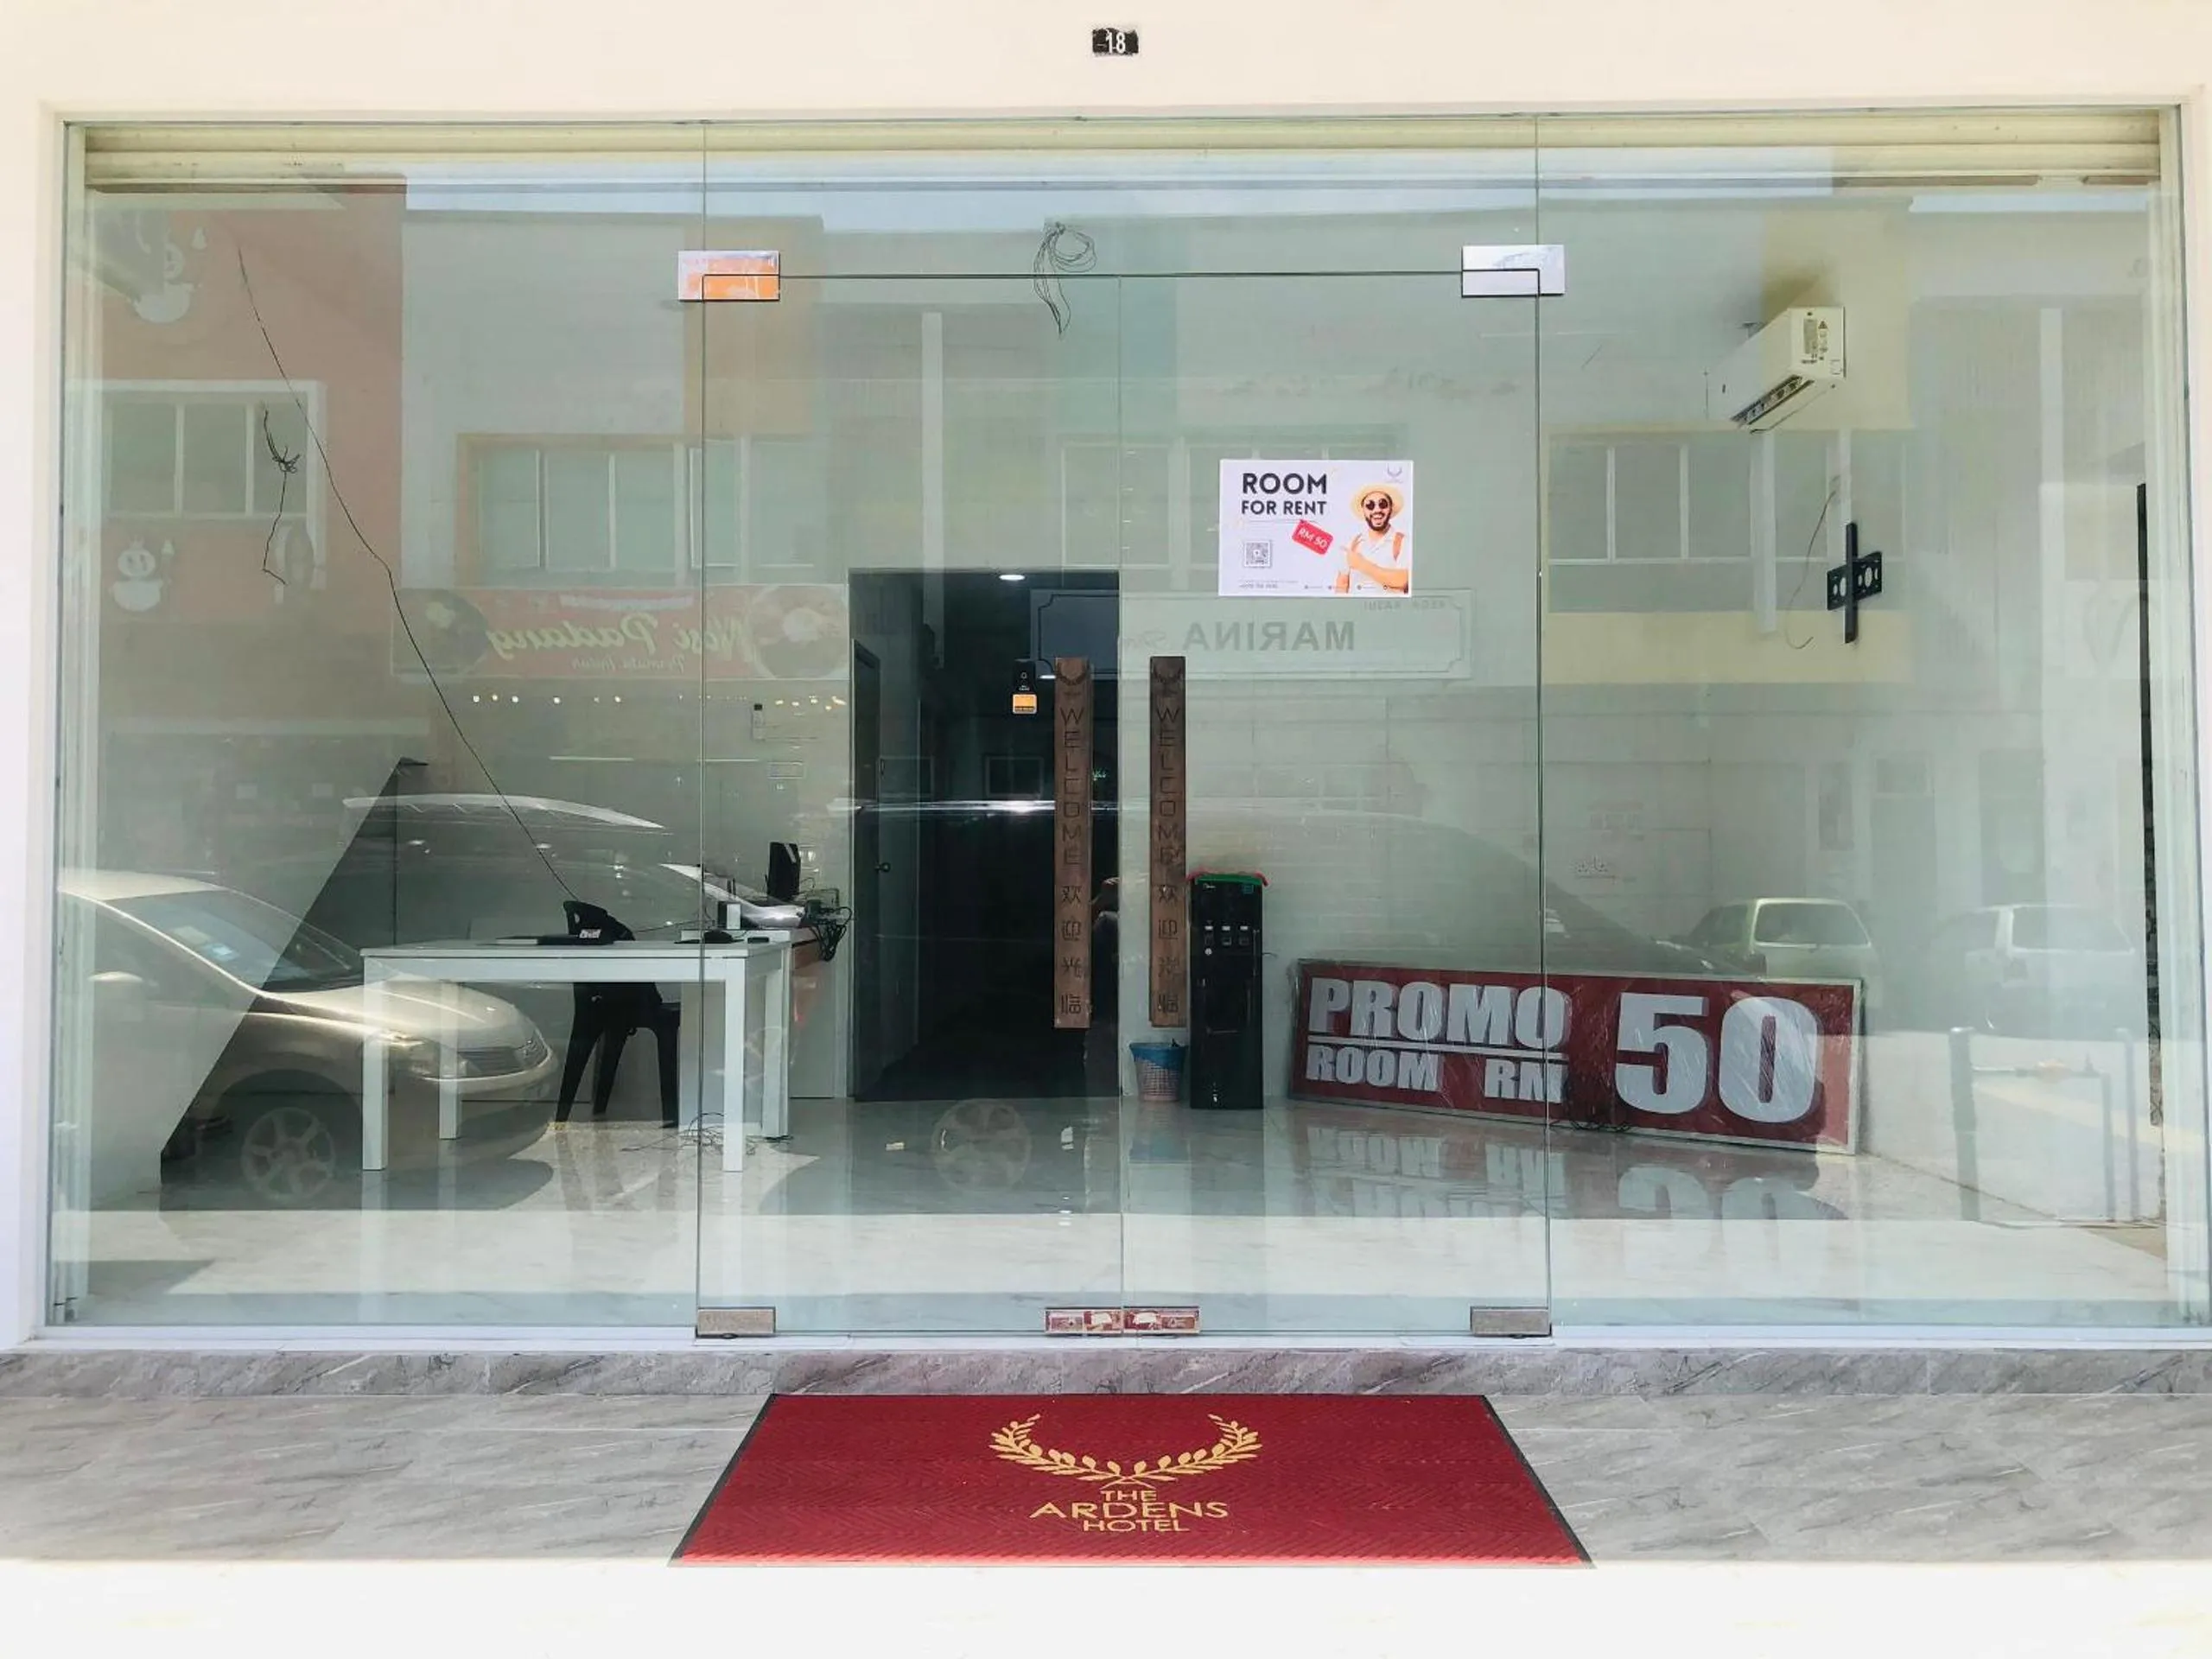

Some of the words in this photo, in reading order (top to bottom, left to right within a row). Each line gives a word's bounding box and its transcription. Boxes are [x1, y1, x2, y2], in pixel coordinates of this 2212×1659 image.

[1106, 32, 1126, 53] 18
[1242, 473, 1327, 494] ROOM
[1242, 500, 1277, 515] FOR
[1283, 500, 1327, 516] RENT
[1298, 527, 1314, 543] RM
[1059, 707, 1085, 864] WELCOME
[1156, 707, 1182, 864] WELCOME
[1307, 977, 1570, 1048] PROMO
[1306, 1046, 1440, 1091] ROOM
[1484, 1058, 1566, 1103] RM
[1615, 992, 1821, 1122] 50
[1100, 1490, 1157, 1501] THE
[1029, 1502, 1229, 1519] ARDENS
[1083, 1519, 1190, 1532] HOTEL
